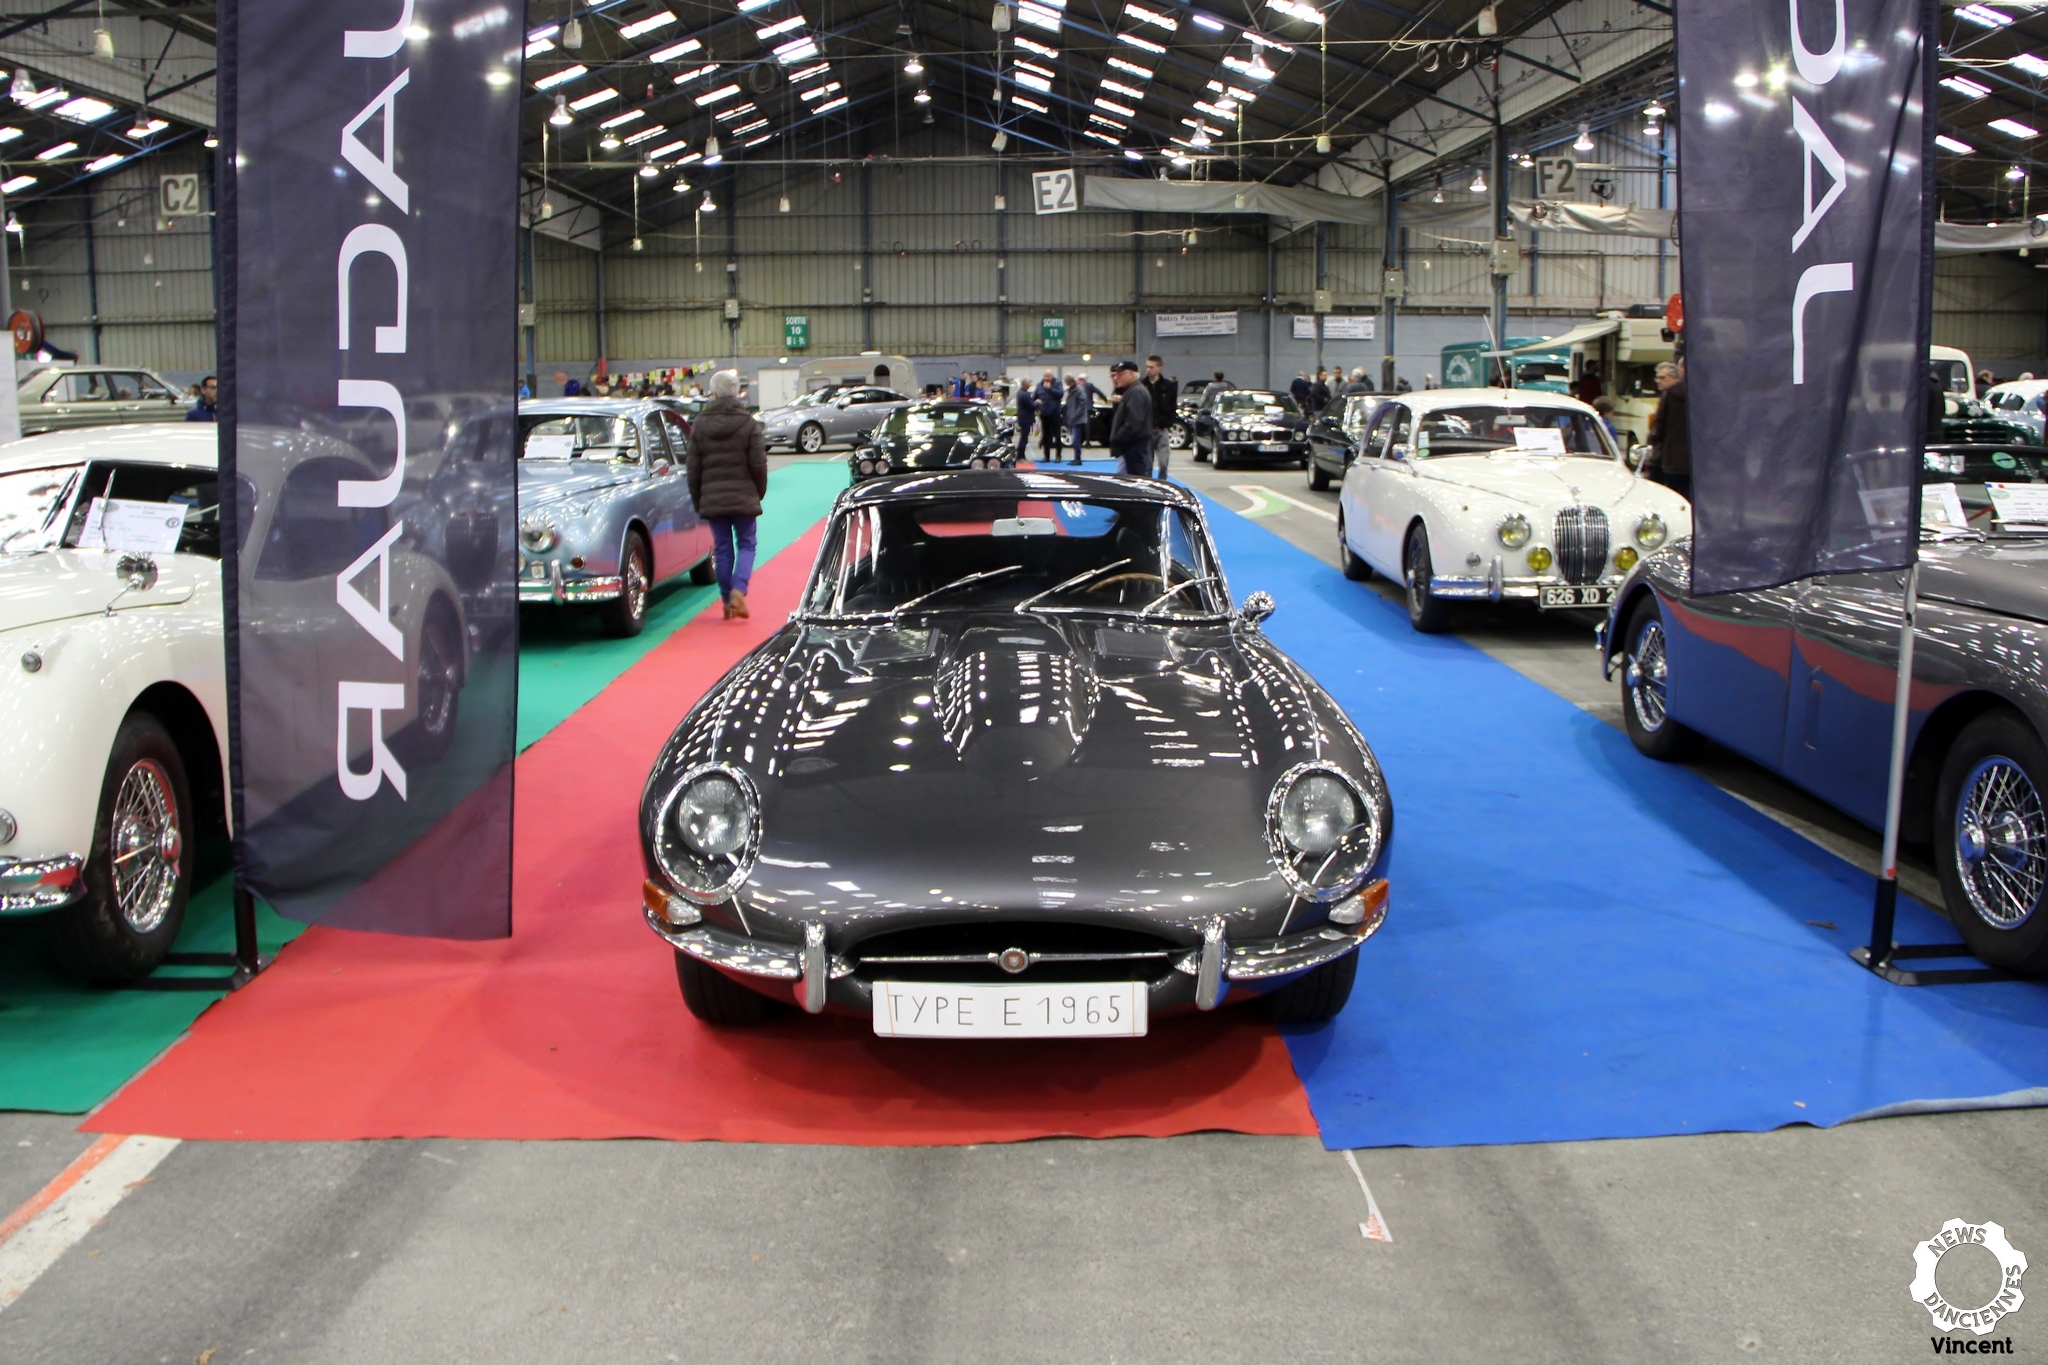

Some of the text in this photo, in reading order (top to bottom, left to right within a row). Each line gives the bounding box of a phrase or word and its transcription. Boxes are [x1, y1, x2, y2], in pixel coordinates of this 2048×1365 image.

[1538, 159, 1575, 194] F2
[163, 178, 197, 212] C2
[1035, 173, 1075, 211] E2
[786, 316, 807, 325] SORTIE
[1043, 318, 1064, 327] SORTIE
[791, 326, 802, 335] 10
[1049, 328, 1058, 337] 11
[1546, 588, 1575, 605] 626
[1581, 588, 1600, 604] XD
[888, 994, 1121, 1026] TYPE E 1965
